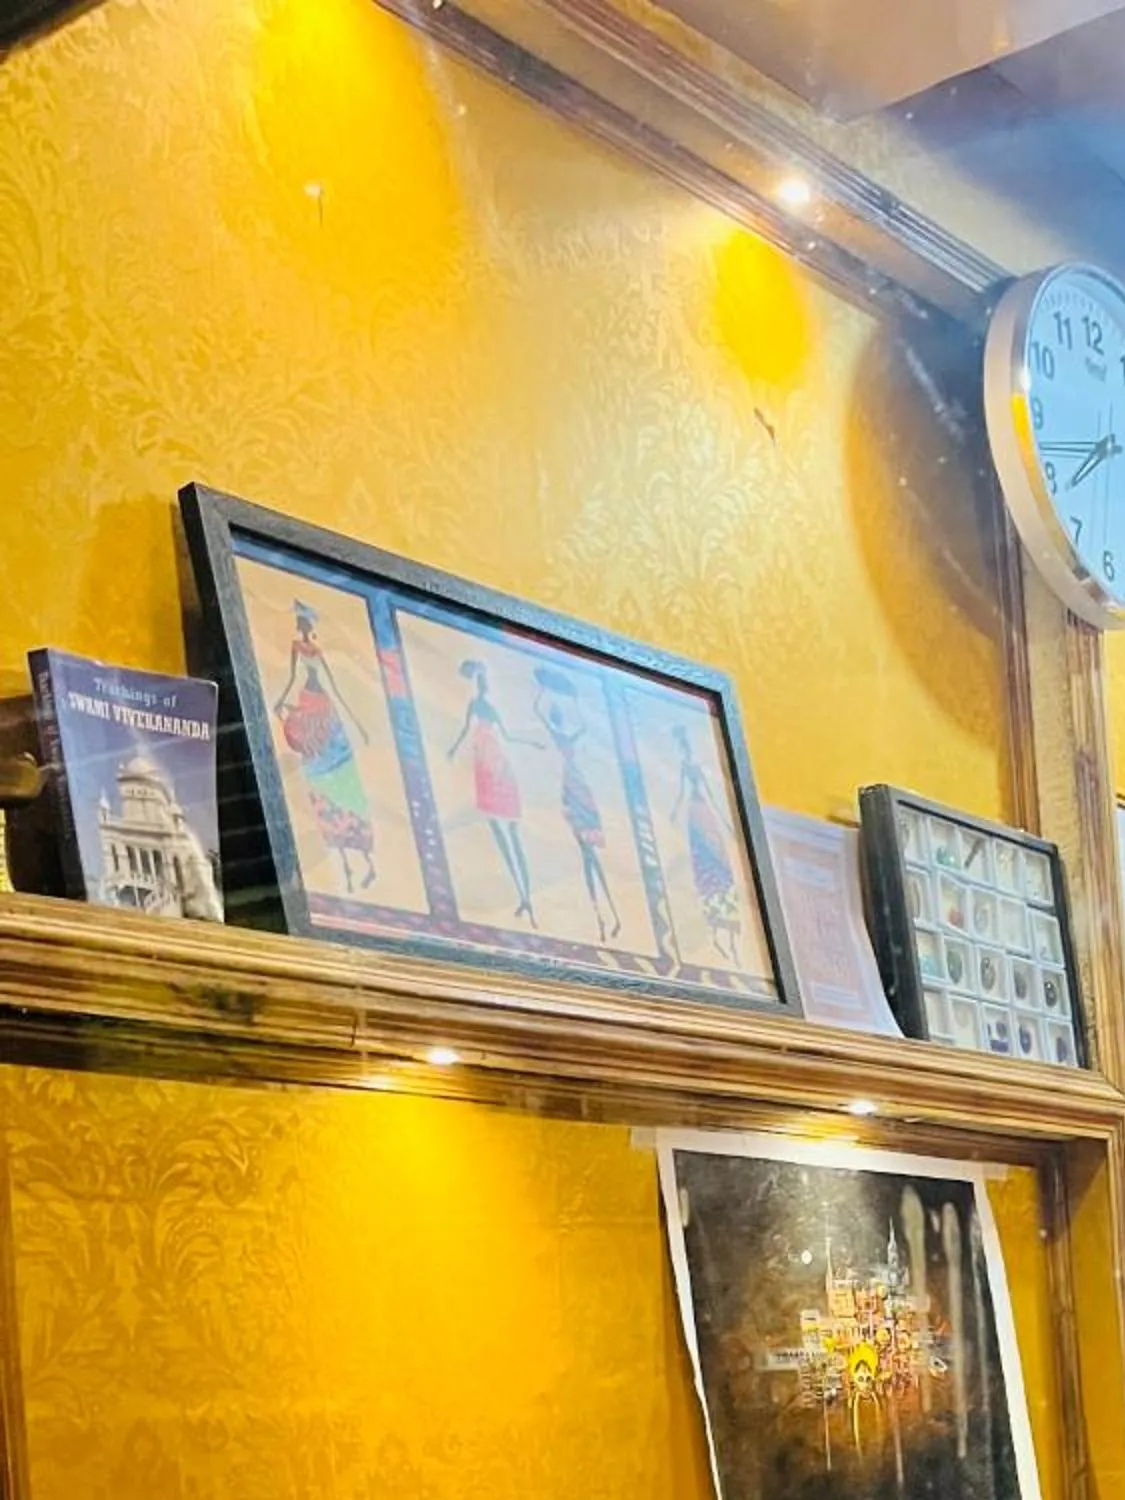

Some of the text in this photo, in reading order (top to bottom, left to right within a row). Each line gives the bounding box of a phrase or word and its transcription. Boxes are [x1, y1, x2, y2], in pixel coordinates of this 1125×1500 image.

[1053, 311, 1073, 351] 11
[1082, 315, 1105, 356] 12
[1033, 340, 1056, 381] 10
[1070, 515, 1083, 545] 7
[1103, 550, 1115, 582] 6
[67, 691, 211, 741] SWAMI VIVEKANANDA
